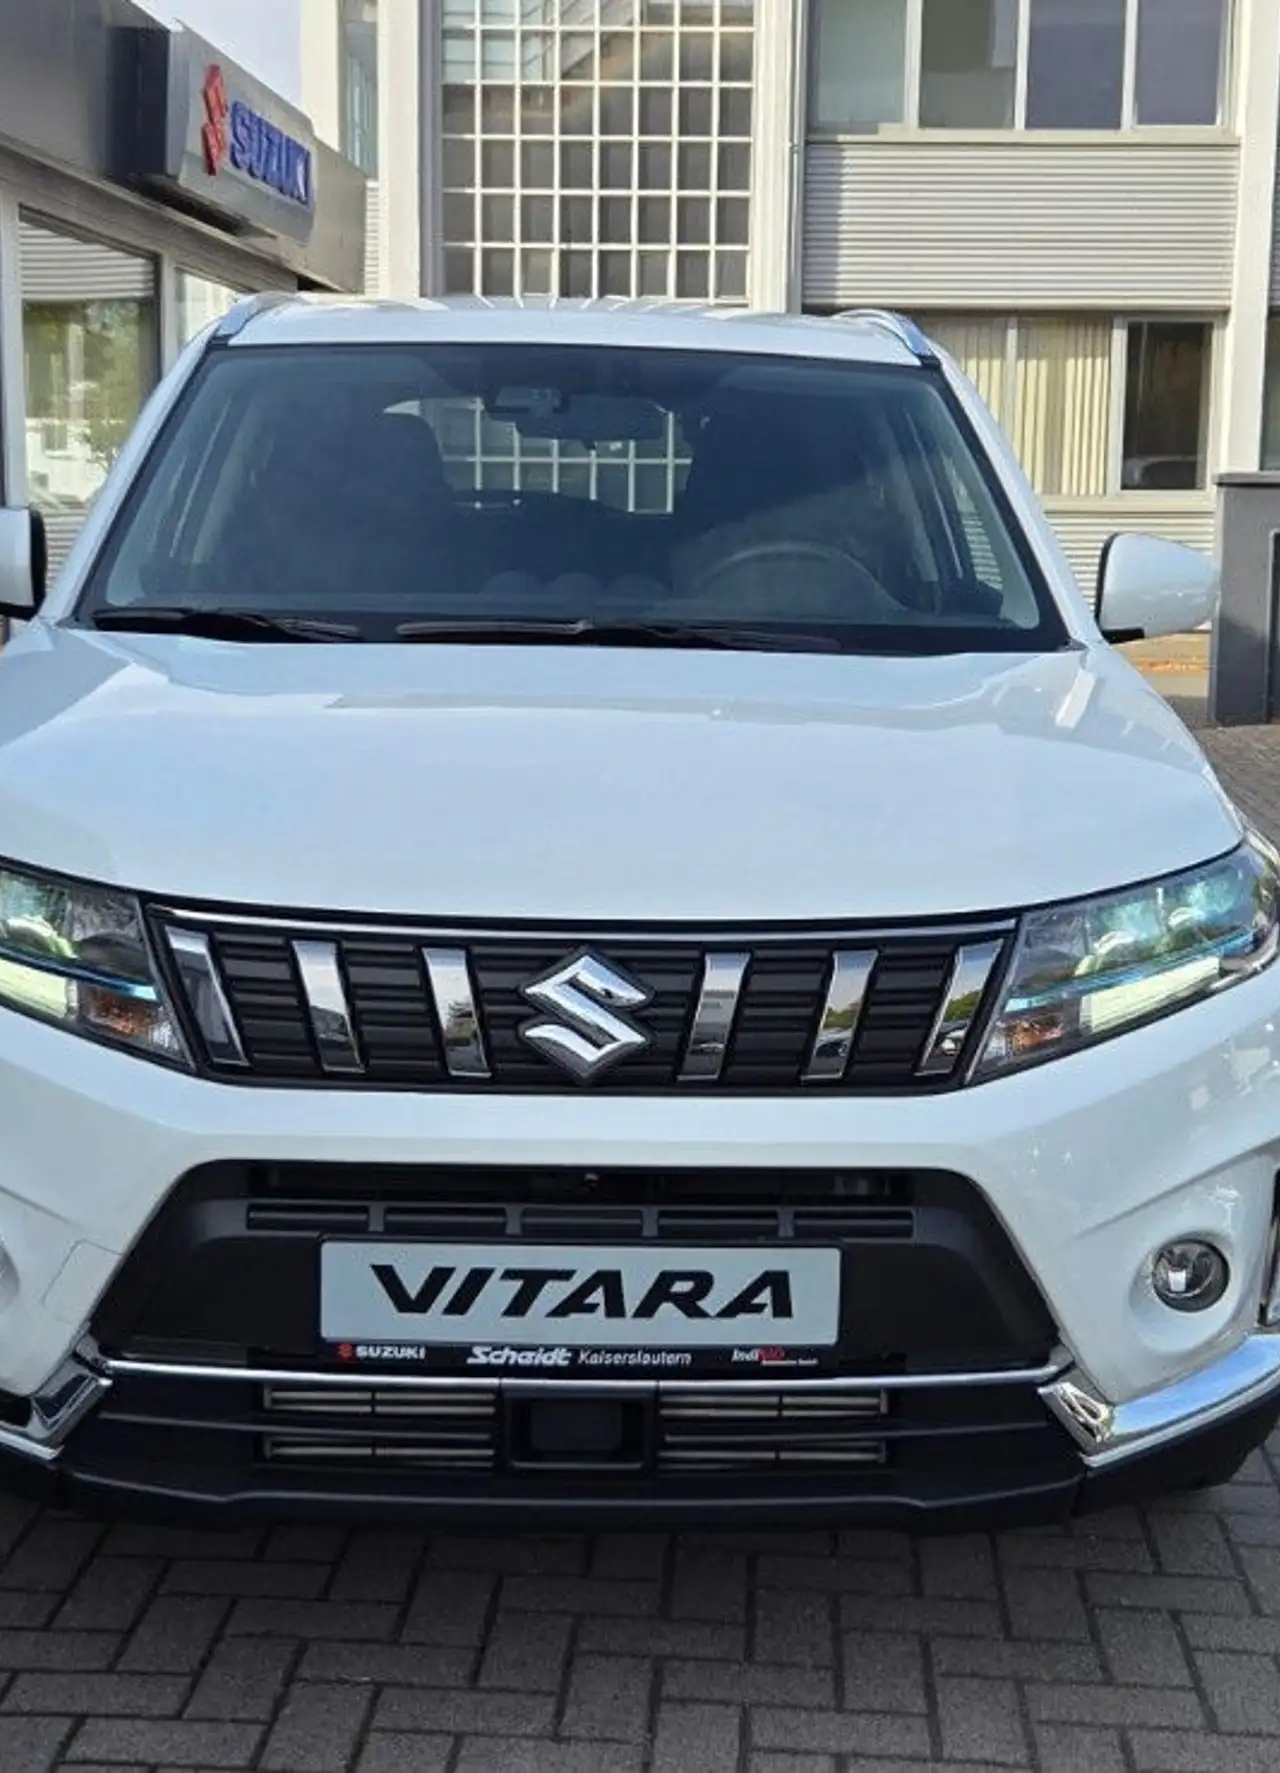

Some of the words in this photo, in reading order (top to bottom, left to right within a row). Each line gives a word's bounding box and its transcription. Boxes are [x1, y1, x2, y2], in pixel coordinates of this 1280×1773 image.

[230, 100, 311, 206] SUZUKI
[370, 1264, 793, 1319] VITARA
[356, 1345, 426, 1360] SUZUKI
[466, 1345, 572, 1367] Schaidt
[577, 1349, 692, 1367] Kaiserslautern
